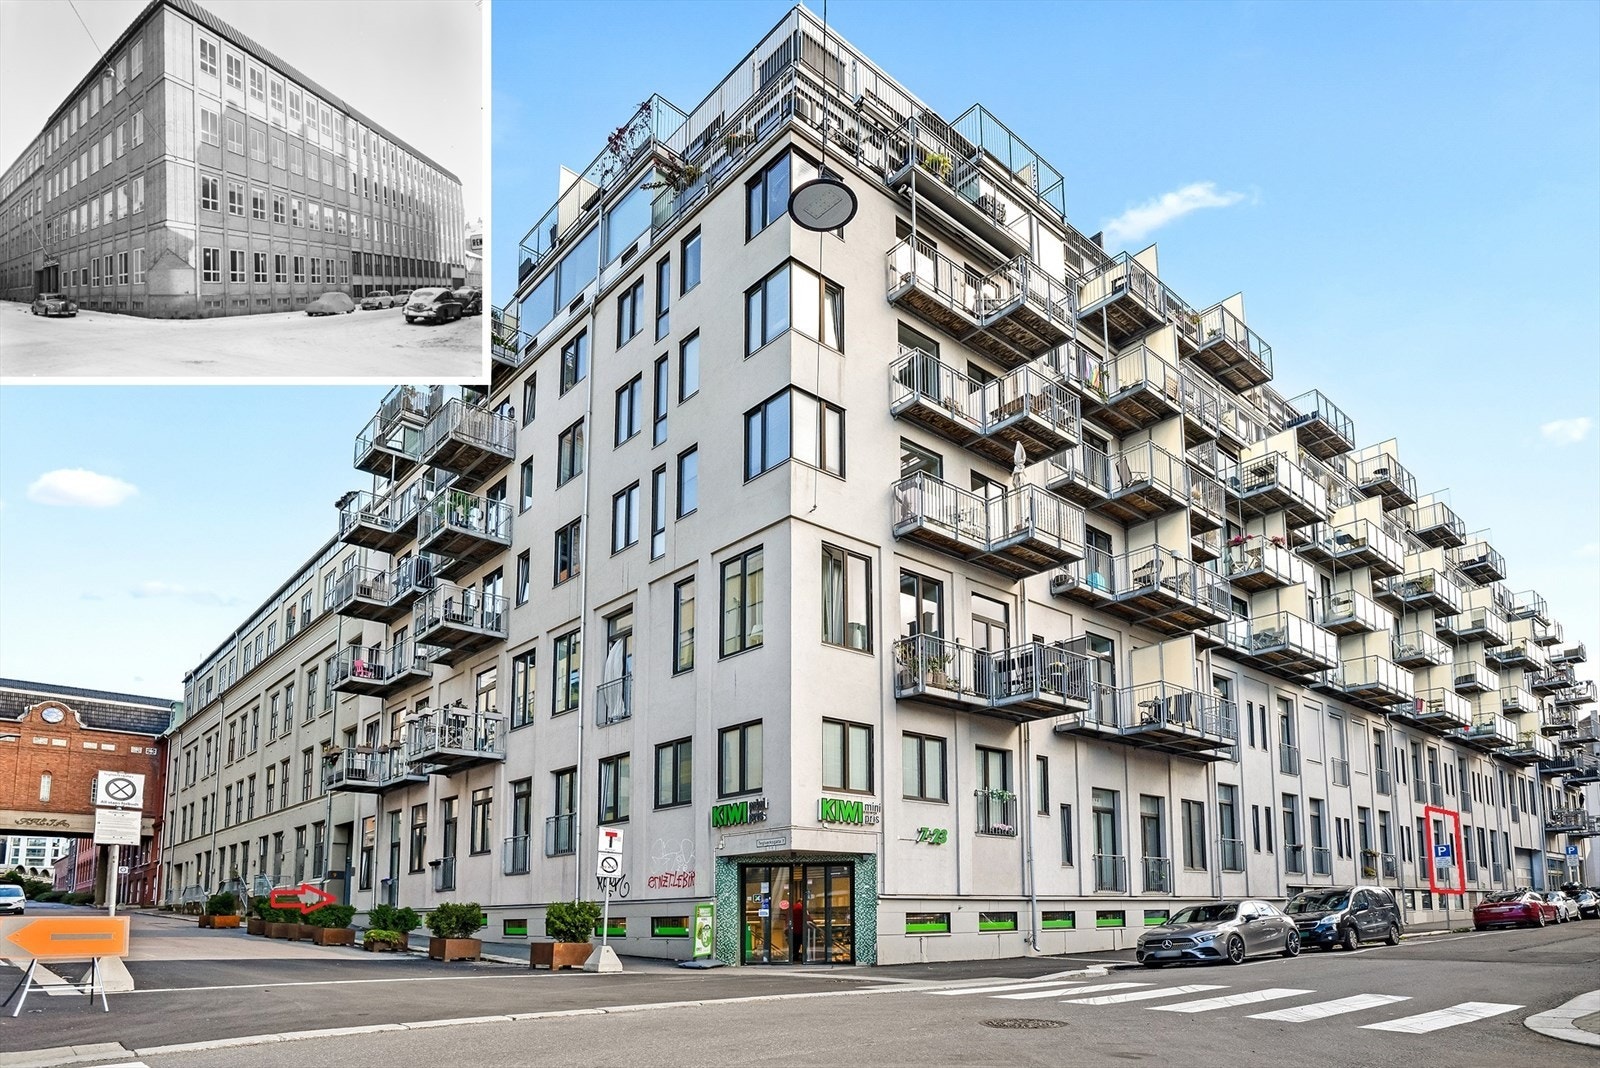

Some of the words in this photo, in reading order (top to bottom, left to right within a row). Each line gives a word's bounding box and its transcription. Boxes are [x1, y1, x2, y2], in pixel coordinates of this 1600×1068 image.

[821, 798, 863, 824] KIWI
[865, 802, 881, 813] mini
[712, 801, 748, 828] KIWI
[865, 816, 880, 824] pris
[918, 827, 947, 843] 7-23
[1437, 846, 1447, 856] P
